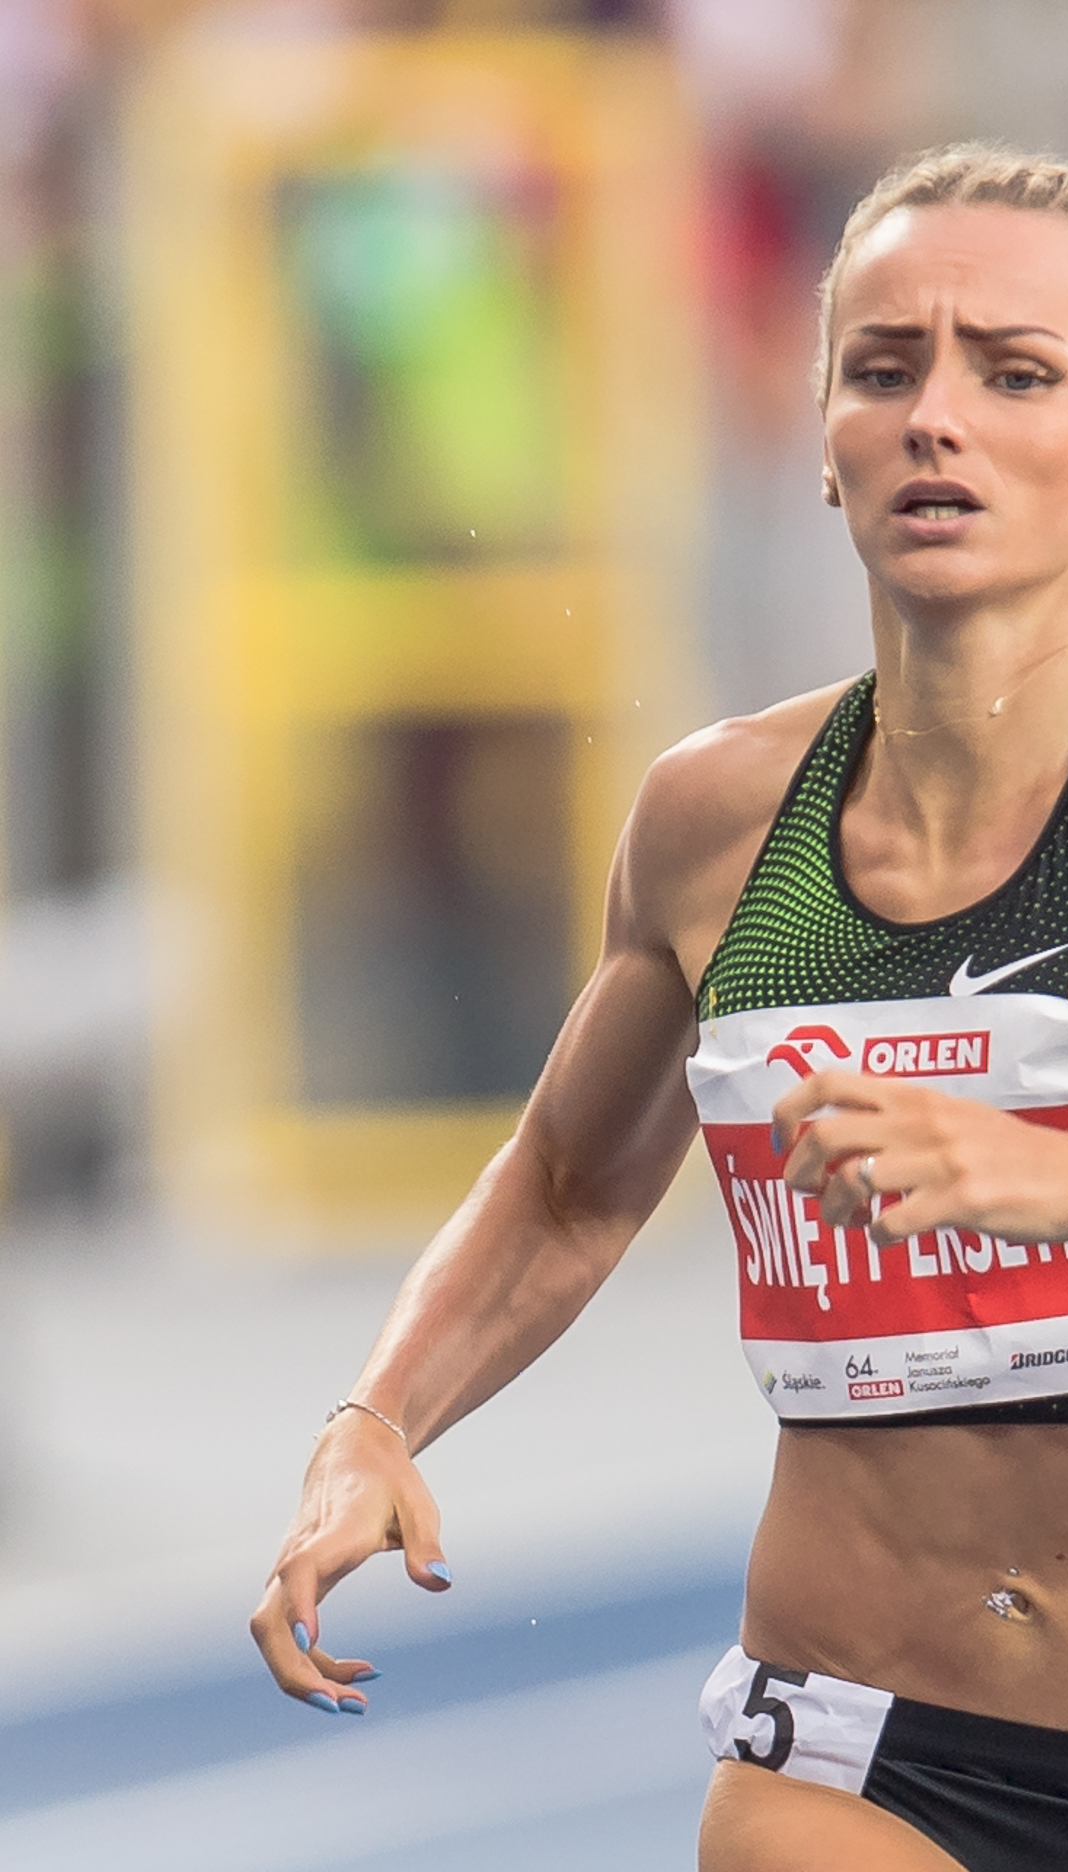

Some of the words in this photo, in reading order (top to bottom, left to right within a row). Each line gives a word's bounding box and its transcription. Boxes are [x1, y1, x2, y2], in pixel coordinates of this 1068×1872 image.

[867, 1036, 983, 1074] ORLEN
[851, 1381, 901, 1398] ORLEN
[733, 1661, 810, 1773] 5
